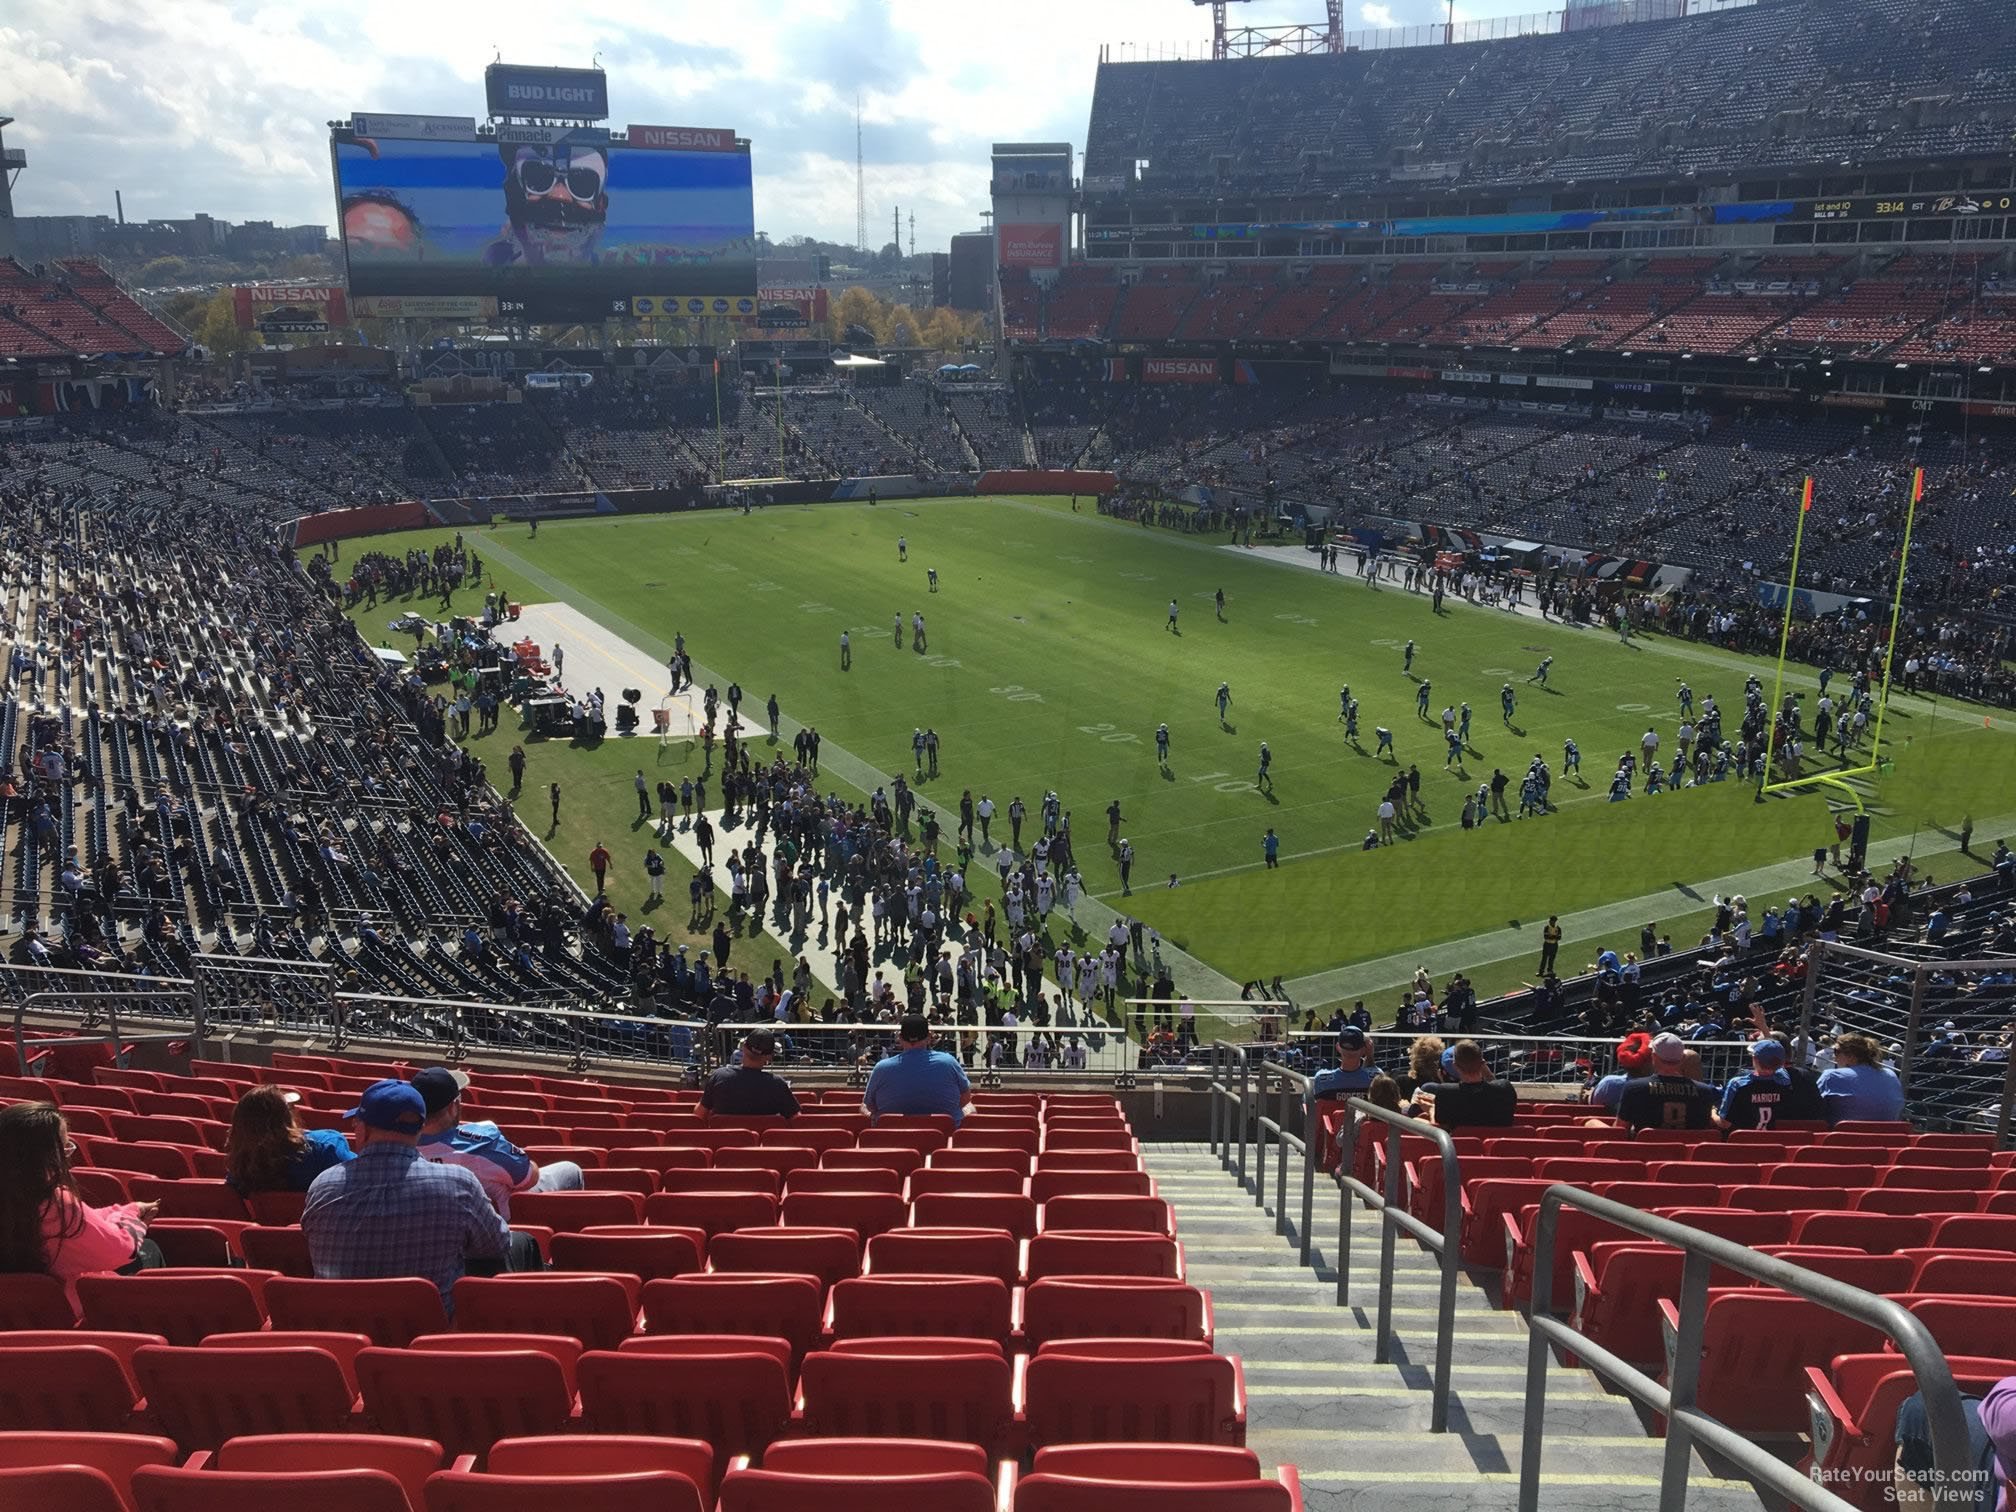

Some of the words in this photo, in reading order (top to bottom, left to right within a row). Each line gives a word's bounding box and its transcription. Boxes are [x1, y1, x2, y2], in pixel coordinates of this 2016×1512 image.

[508, 85, 545, 100] BUD
[546, 87, 595, 102] LIGHT
[498, 125, 552, 142] Pinnacle
[644, 131, 720, 146] NISSAN
[1876, 202, 1905, 213] 33:14
[251, 288, 330, 300] NISSAN
[757, 289, 816, 300] NISSAN
[1147, 363, 1213, 374] NISSAN
[1912, 400, 1934, 411] CMT
[1076, 723, 1139, 743] 20
[1188, 772, 1256, 793] 10
[1040, 887, 1049, 895] 77
[1648, 1081, 1699, 1097] MARIOTA
[1751, 1093, 1781, 1103] MARIOTA
